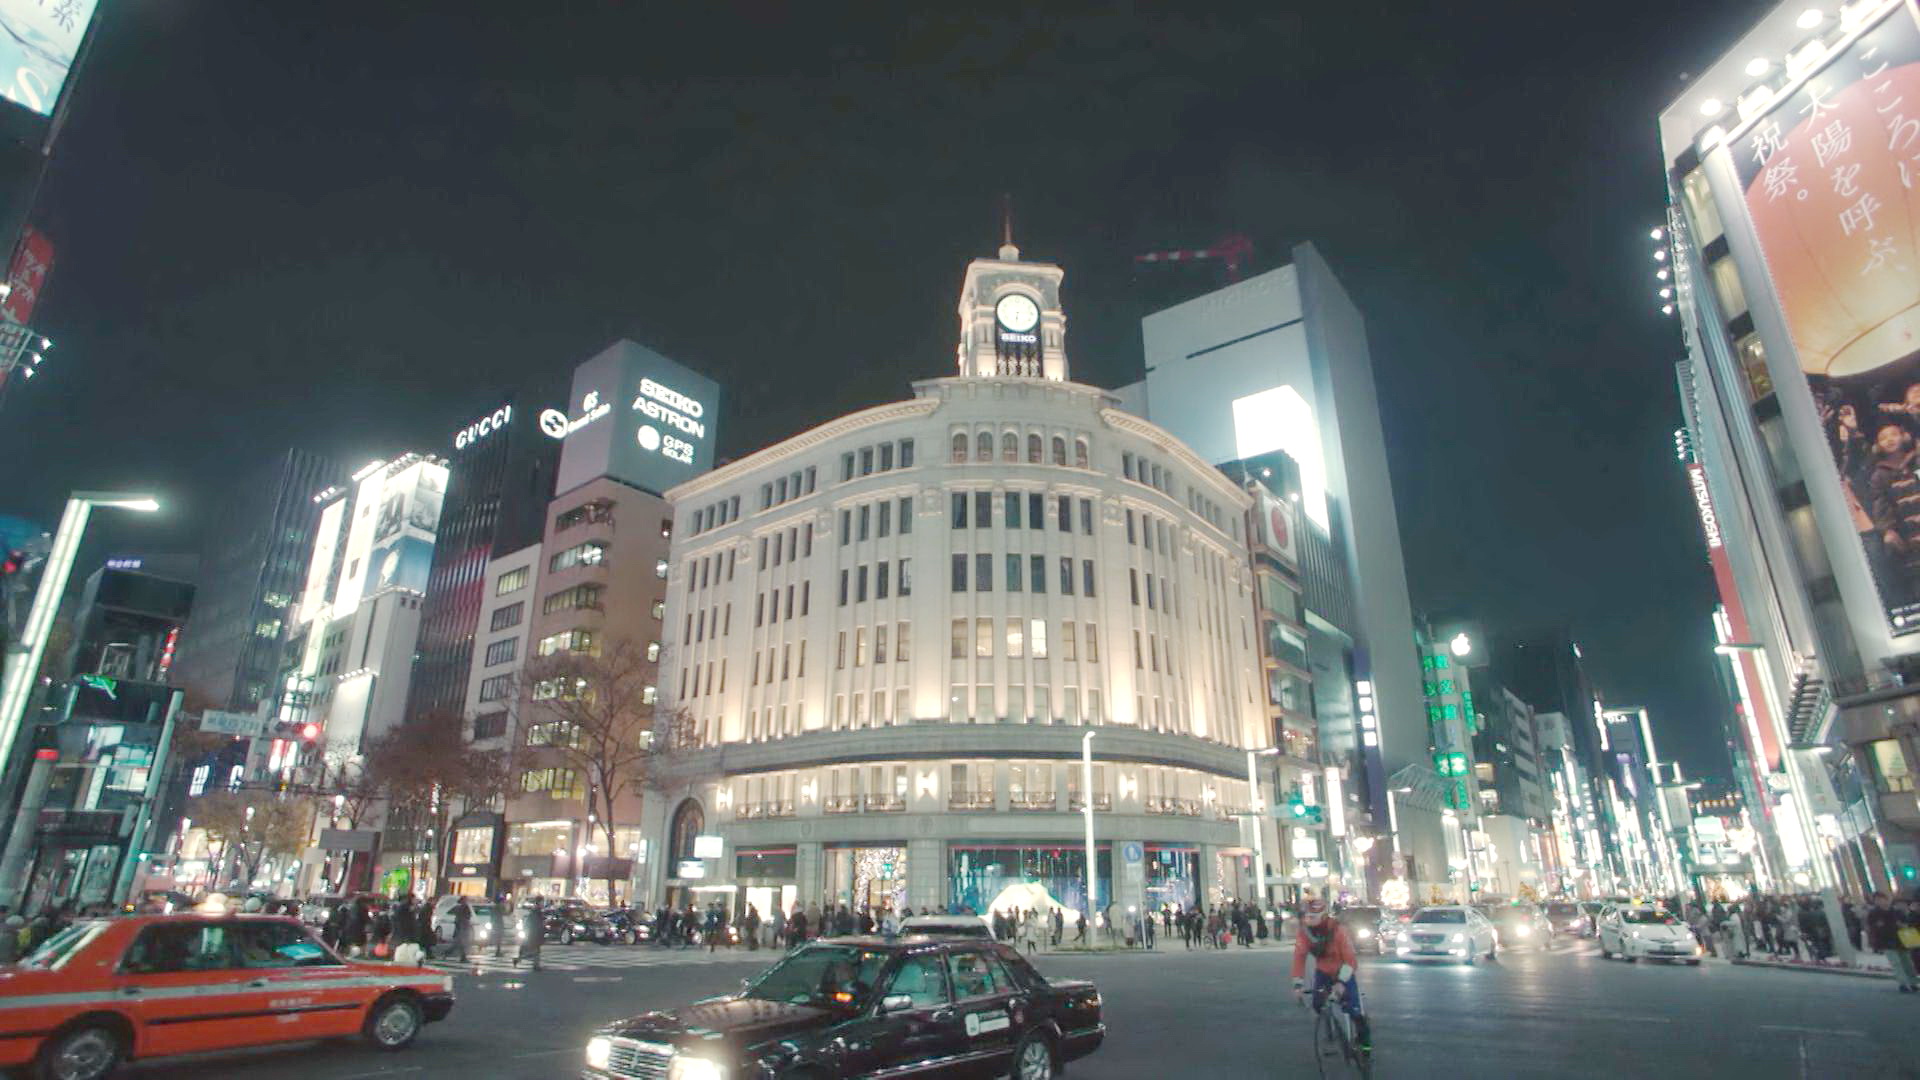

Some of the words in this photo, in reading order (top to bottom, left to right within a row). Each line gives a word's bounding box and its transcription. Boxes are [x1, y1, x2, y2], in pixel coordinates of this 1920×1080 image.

[1800, 85, 1908, 275] 太陽を呼ぶ
[1001, 333, 1037, 343] SEIKO
[632, 396, 705, 439] ASTRON
[640, 377, 703, 418] SEIKO
[455, 404, 511, 450] GUCCI
[663, 434, 694, 455] GPS
[1688, 468, 1722, 549] MITSUKOSHI
